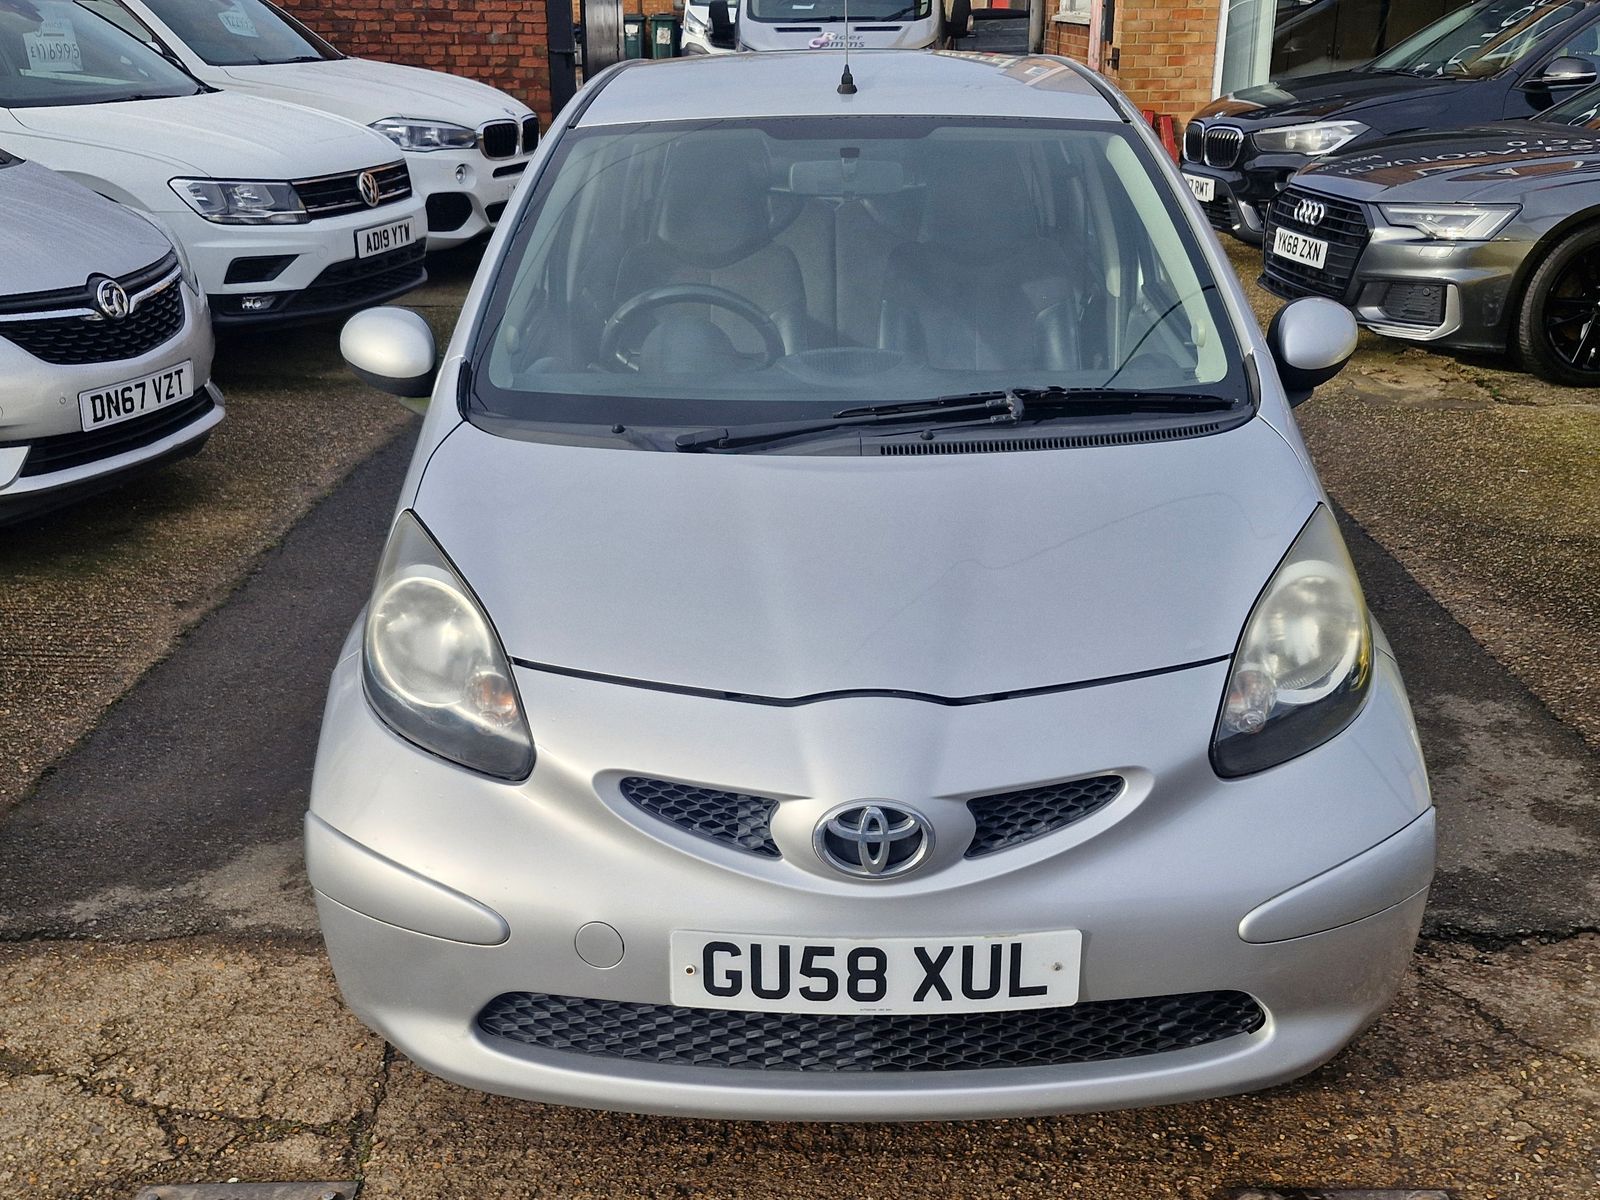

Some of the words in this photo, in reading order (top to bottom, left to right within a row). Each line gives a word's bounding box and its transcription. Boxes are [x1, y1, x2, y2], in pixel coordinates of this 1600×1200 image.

[1195, 180, 1209, 196] RMT
[366, 229, 390, 253] AD19
[1277, 232, 1299, 255] YK68
[1299, 236, 1322, 262] ZXN
[90, 381, 146, 424] DN67
[152, 368, 184, 404] VZT
[702, 941, 888, 1002] GU58
[913, 942, 1048, 1002] XUL
